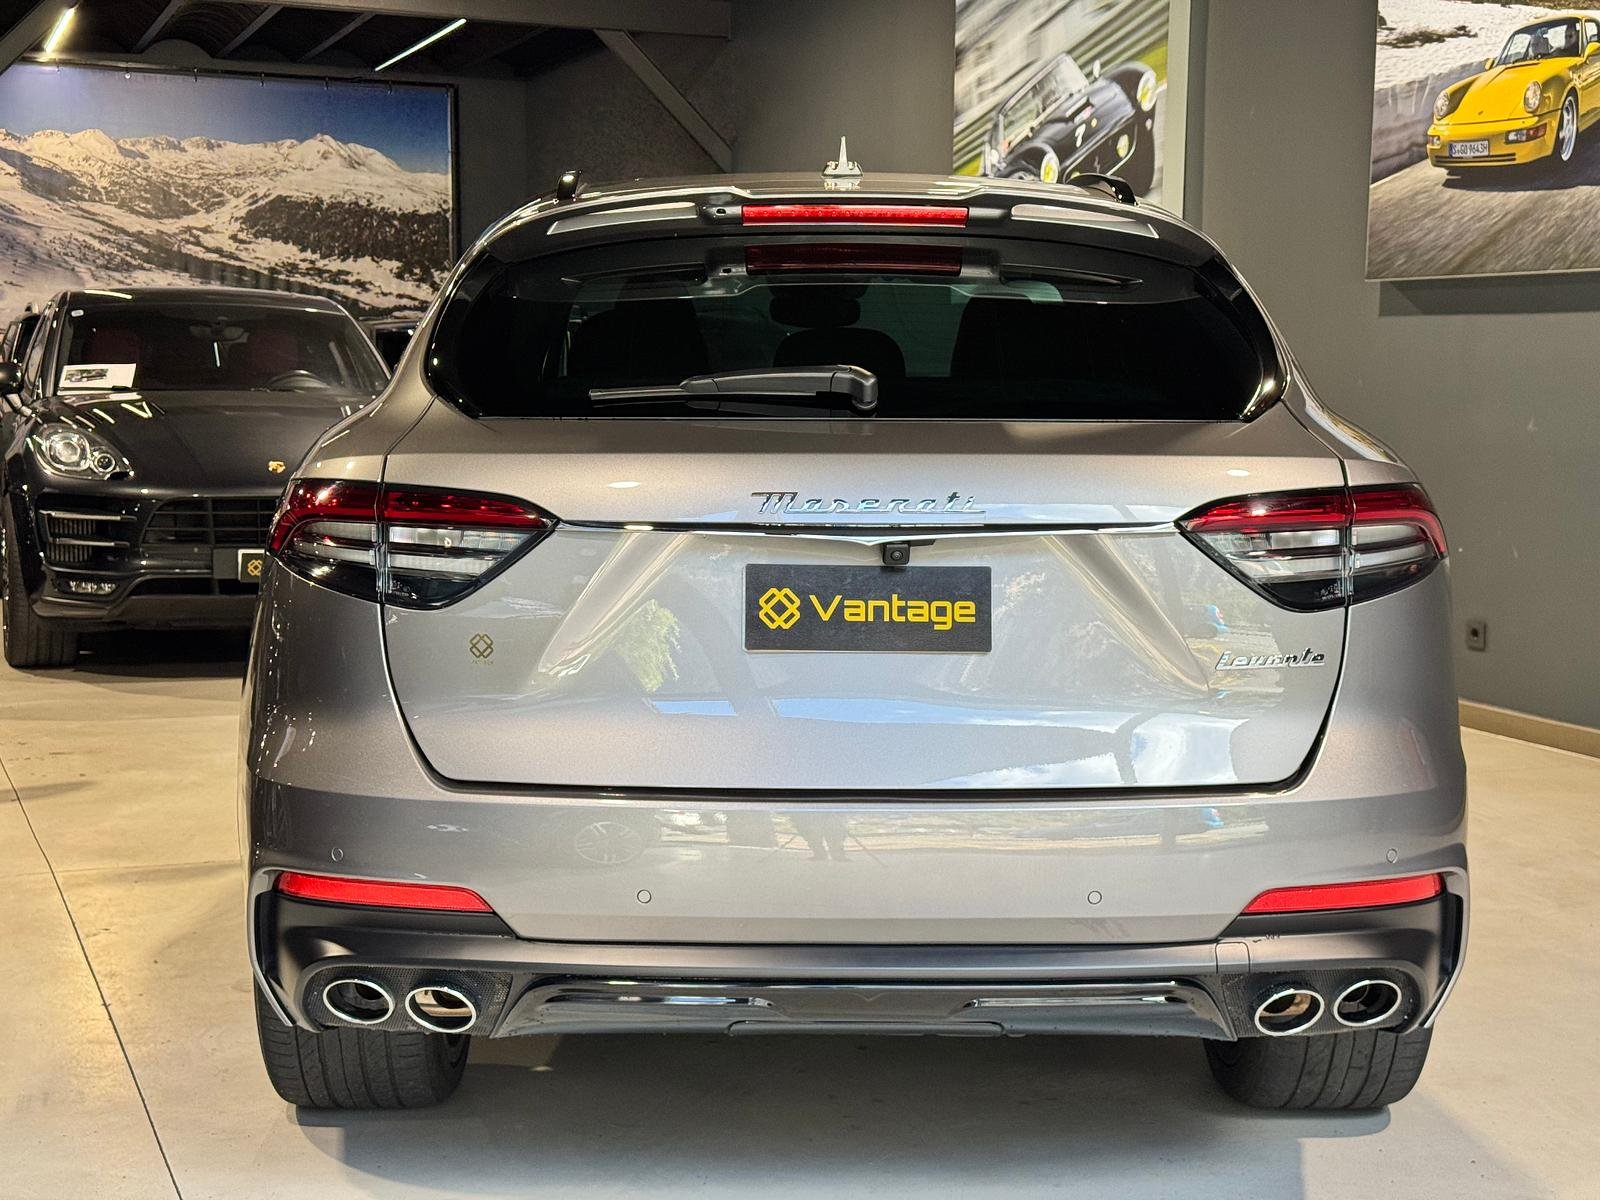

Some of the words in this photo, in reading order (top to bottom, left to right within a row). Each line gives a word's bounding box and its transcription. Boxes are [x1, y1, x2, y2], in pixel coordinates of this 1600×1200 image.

[751, 491, 985, 514] Maserati
[809, 593, 977, 631] Vantage
[1215, 647, 1326, 671] Levante
